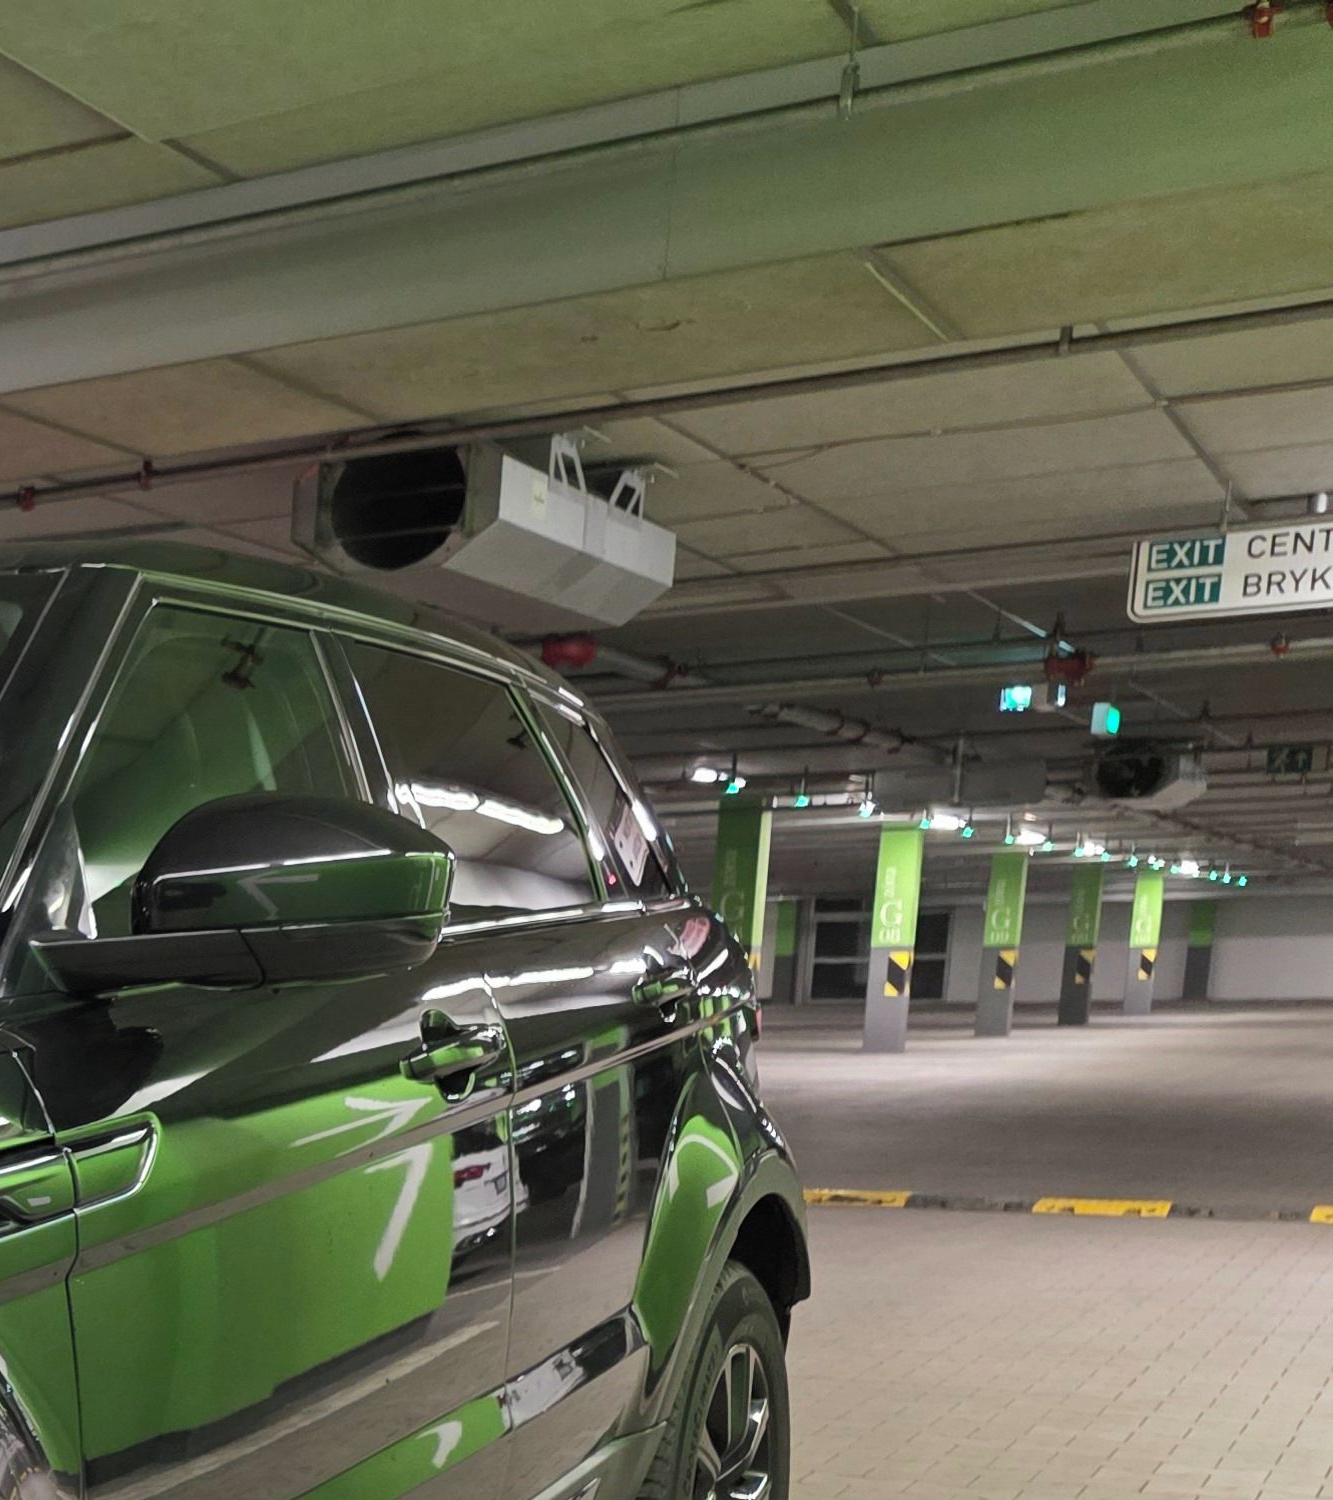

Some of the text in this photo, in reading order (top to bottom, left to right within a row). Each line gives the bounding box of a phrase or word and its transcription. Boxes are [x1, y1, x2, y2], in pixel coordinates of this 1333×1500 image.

[1150, 538, 1223, 570] EXIT
[1146, 567, 1333, 608] EXIT BRYK
[880, 899, 902, 928] G
